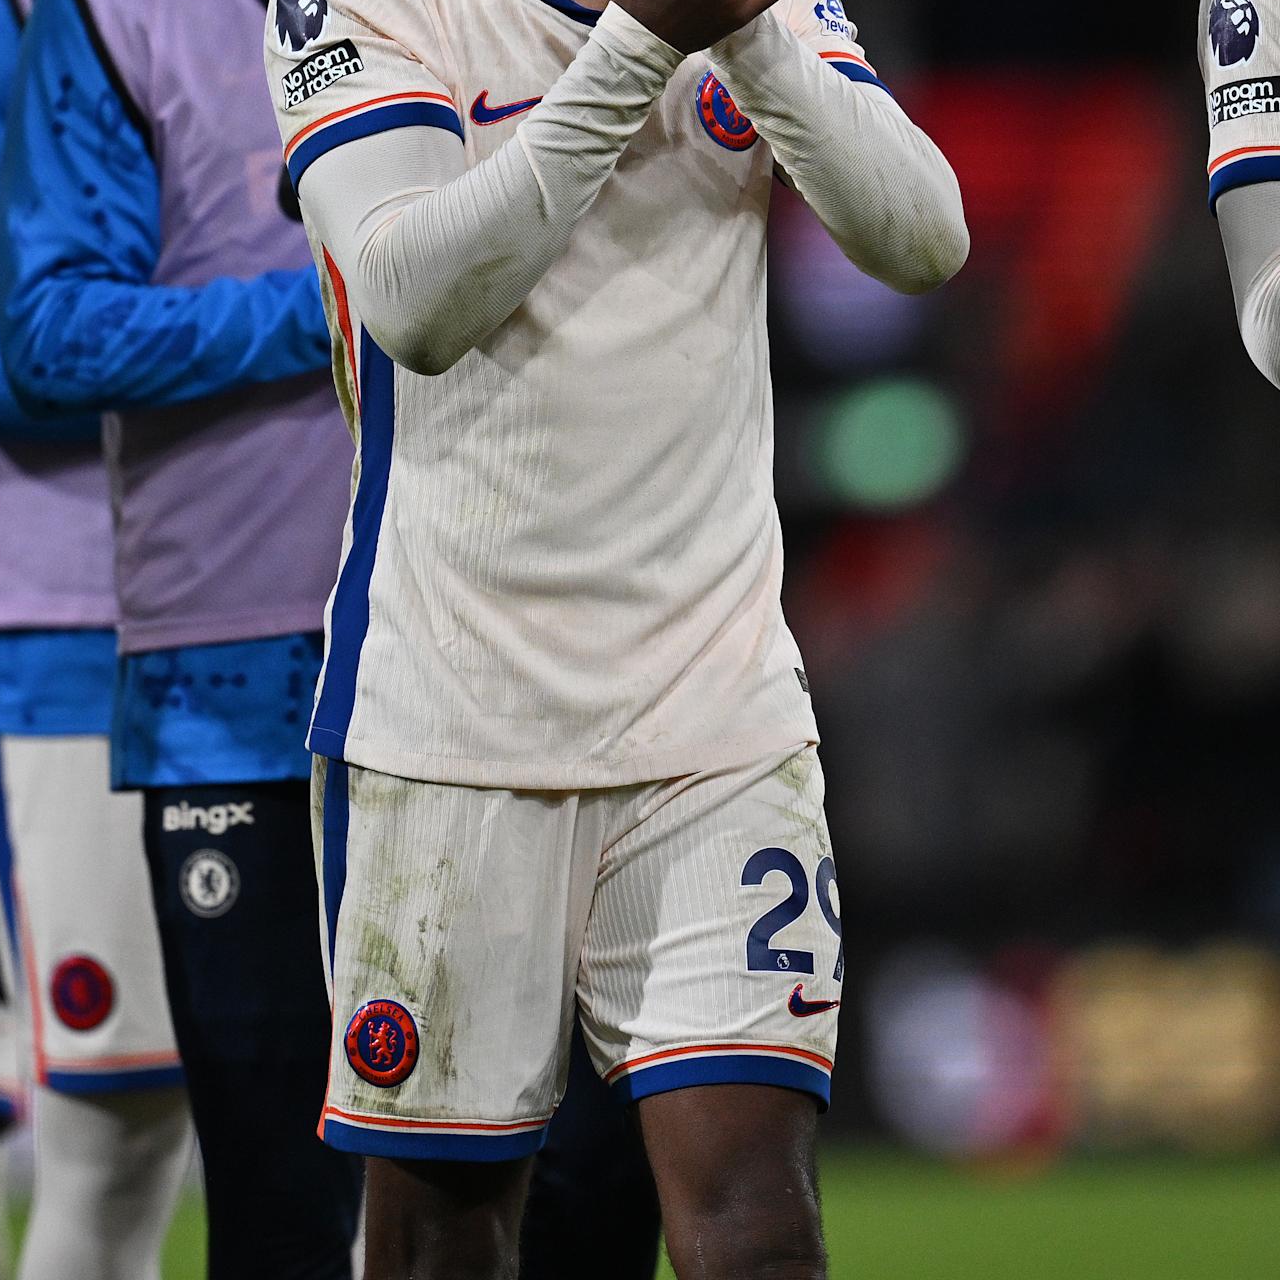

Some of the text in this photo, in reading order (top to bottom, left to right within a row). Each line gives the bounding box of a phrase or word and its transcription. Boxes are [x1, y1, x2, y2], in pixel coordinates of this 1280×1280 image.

[283, 46, 349, 95] No room
[306, 58, 363, 96] racism
[1223, 81, 1273, 104] room
[359, 1003, 405, 1023] CHELSEA
